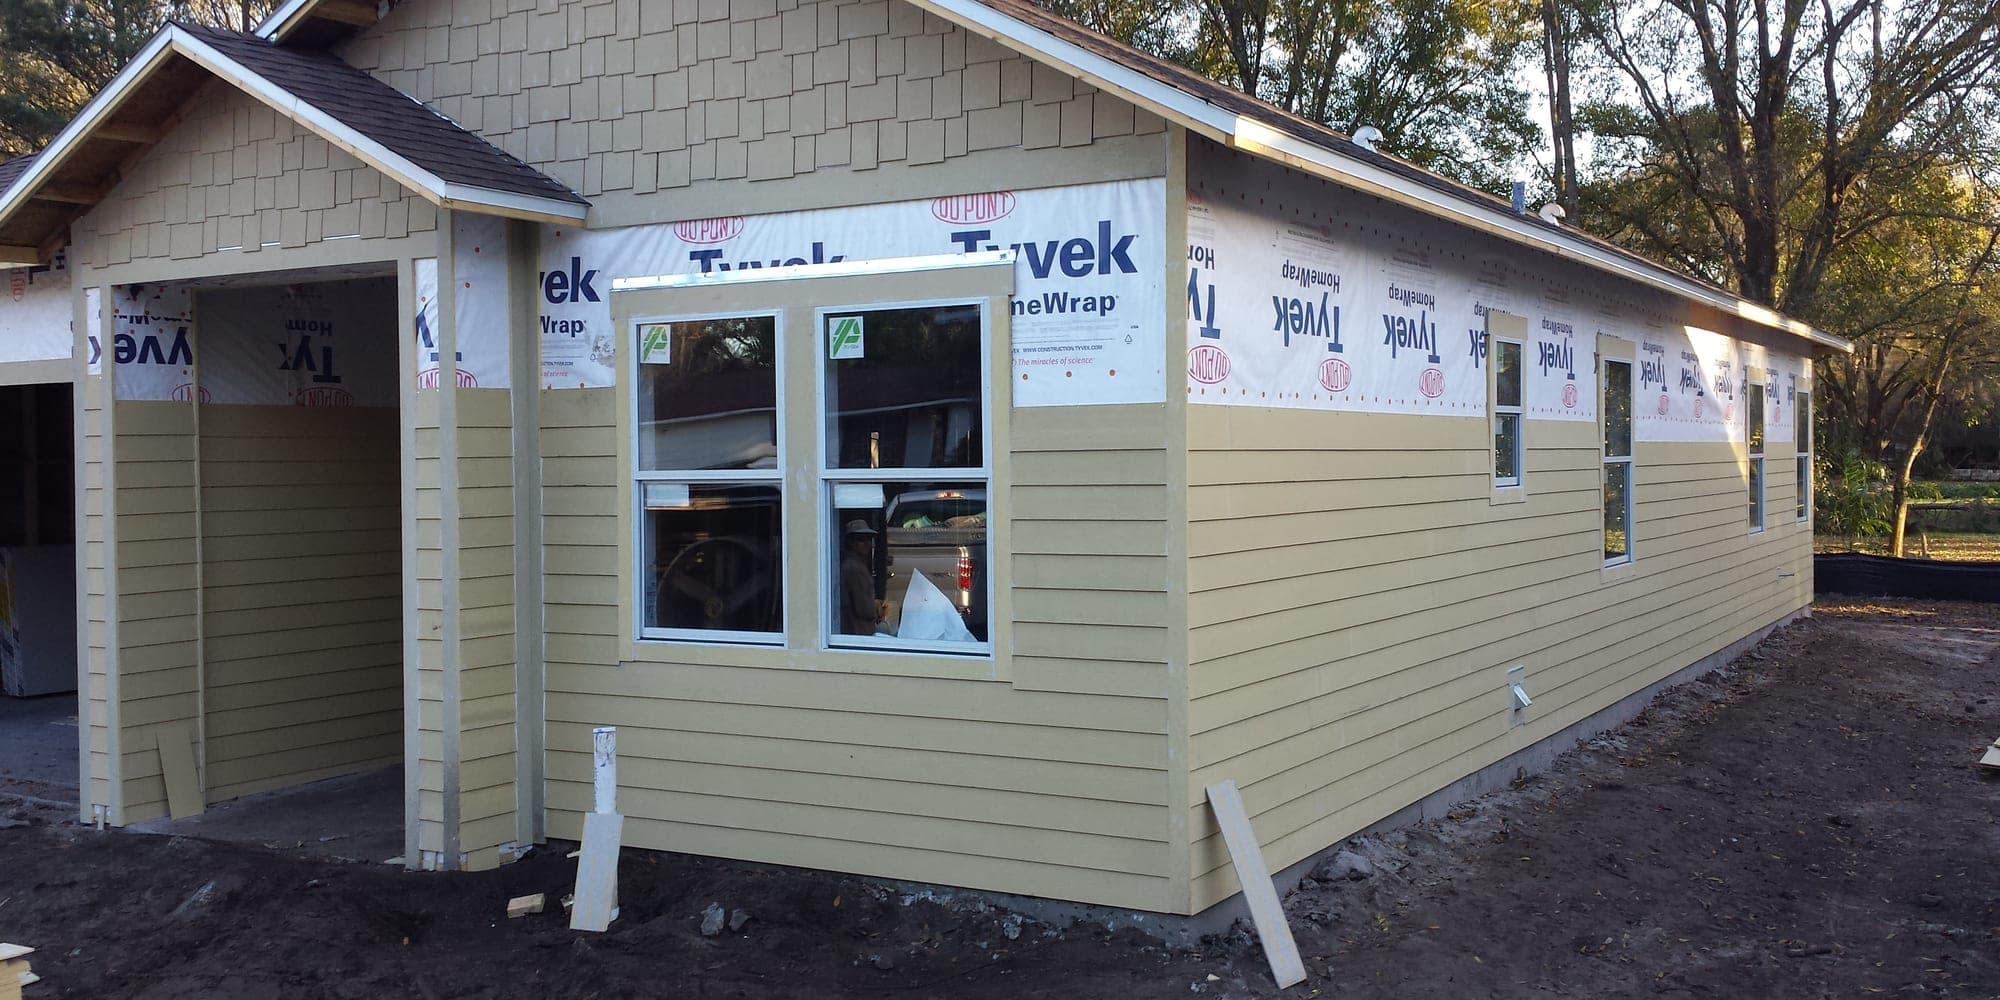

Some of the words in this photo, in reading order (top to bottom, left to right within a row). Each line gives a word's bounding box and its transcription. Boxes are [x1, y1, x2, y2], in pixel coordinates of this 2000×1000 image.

[951, 220, 1138, 279] Tvek
[1282, 259, 1340, 293] HomeWrap
[1388, 283, 1435, 312] HomeWrap
[1272, 292, 1343, 353] Tyvek
[1383, 310, 1440, 364] Tyvek
[1030, 357, 1059, 365] miracles
[1538, 338, 1576, 380] Tyvek
[1641, 356, 1668, 392] Tyvek
